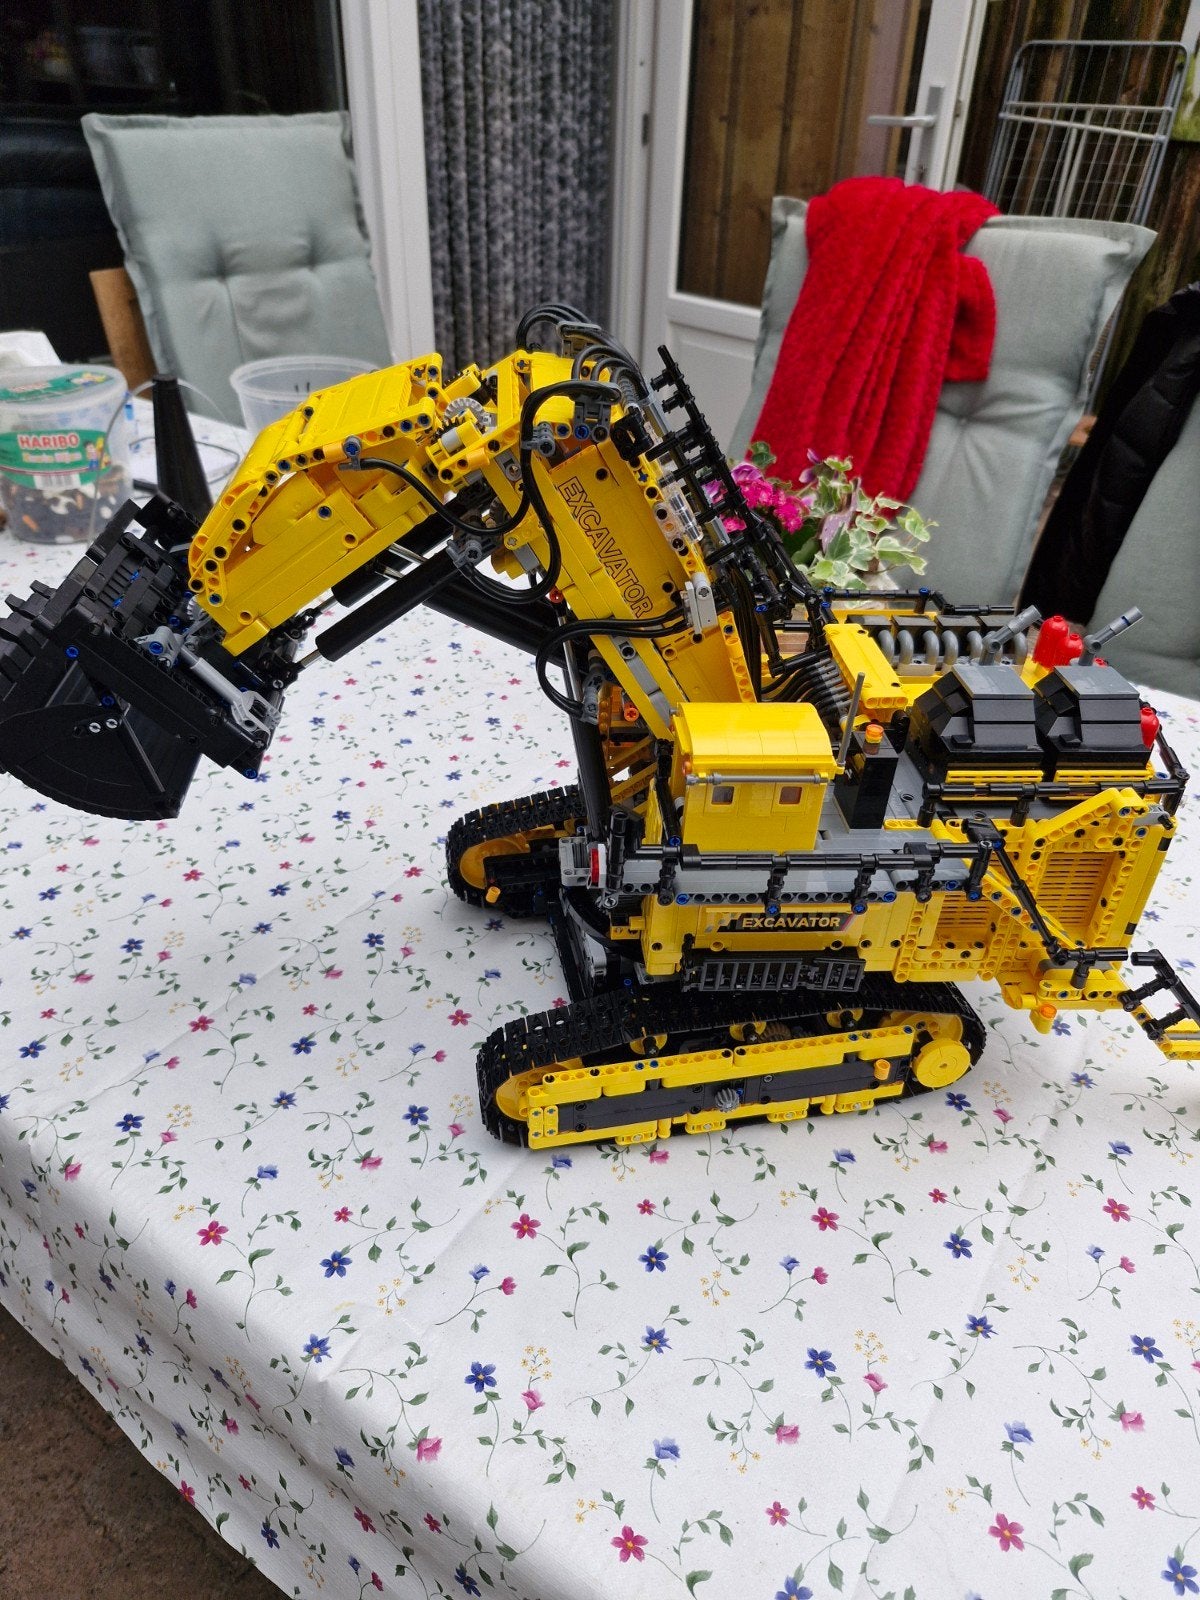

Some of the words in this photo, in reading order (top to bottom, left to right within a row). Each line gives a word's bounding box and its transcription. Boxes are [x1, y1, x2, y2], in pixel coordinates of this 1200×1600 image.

[18, 433, 79, 449] HARIBO
[558, 476, 653, 618] EXCAVATOR
[742, 917, 840, 928] EXCAVATOR
